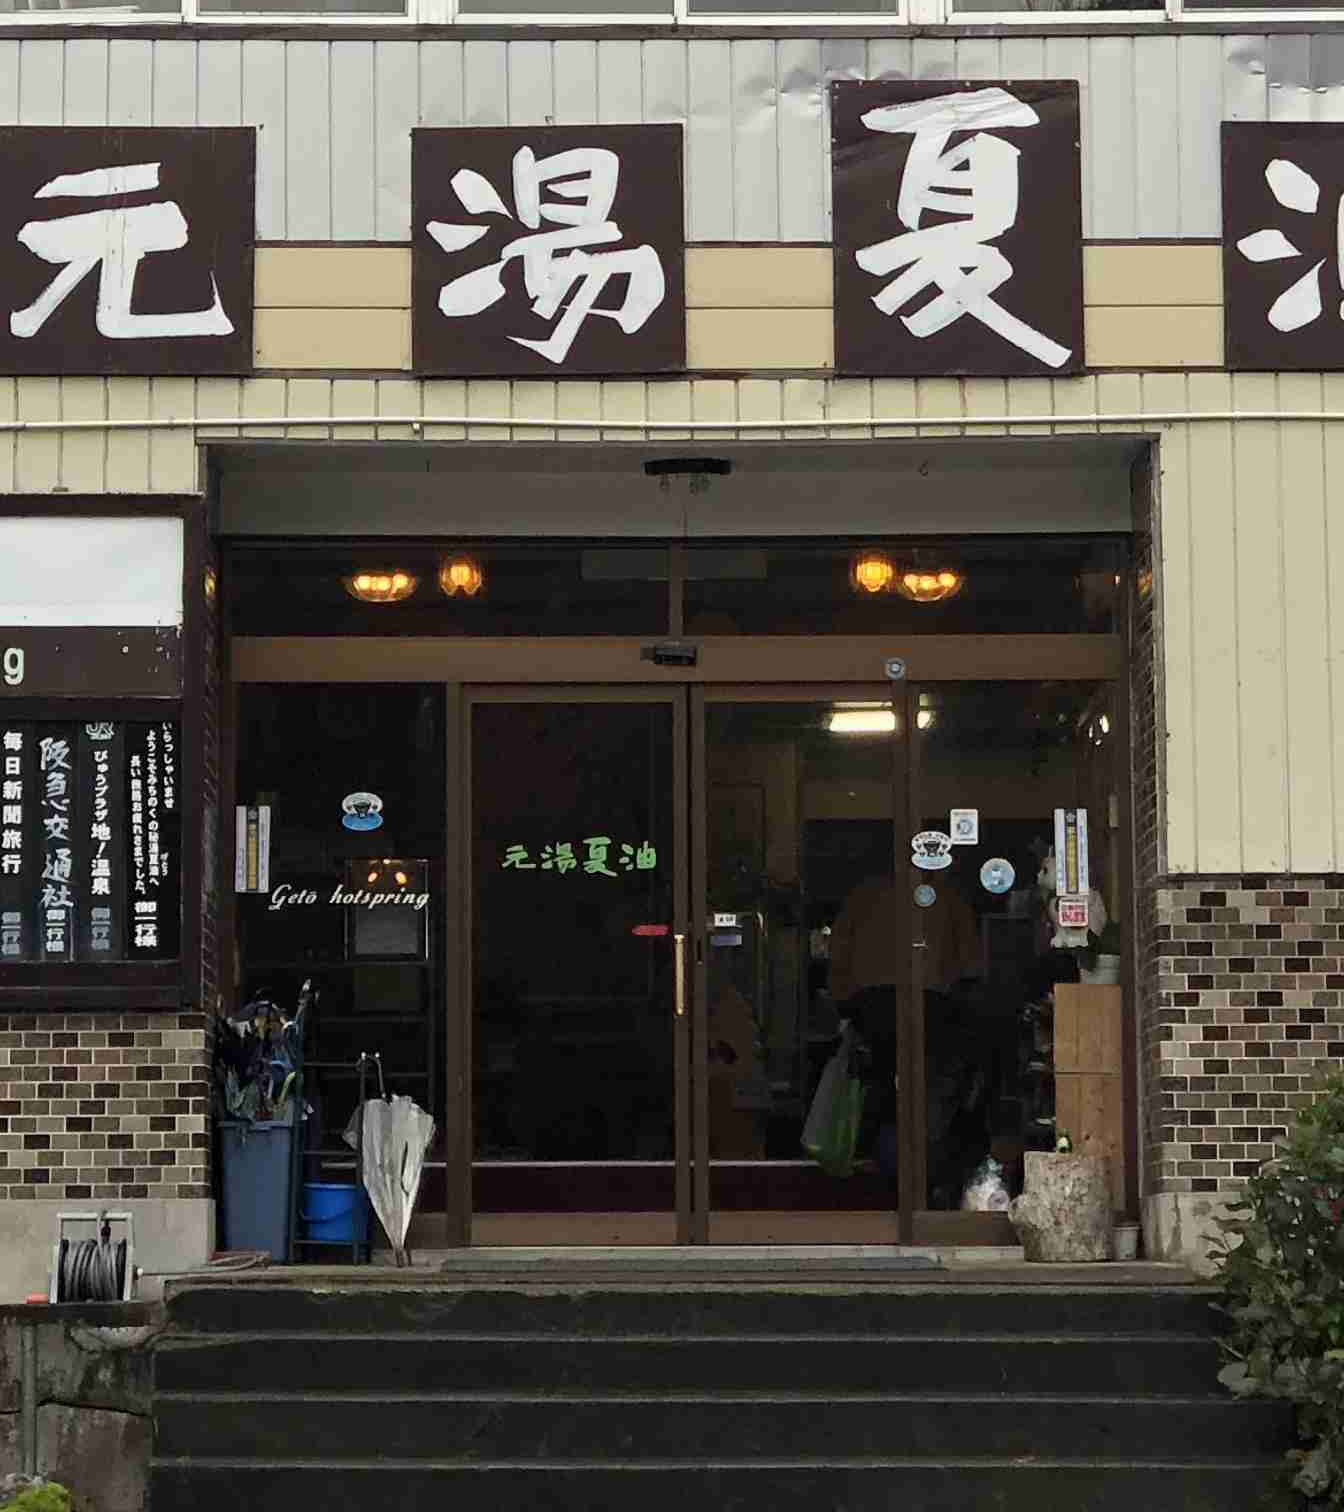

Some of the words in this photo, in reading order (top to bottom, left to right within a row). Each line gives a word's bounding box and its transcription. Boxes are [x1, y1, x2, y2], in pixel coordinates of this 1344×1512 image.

[1, 731, 23, 874] 毎日新聞旅行
[39, 737, 75, 908] 阪急交通社
[162, 722, 175, 809] いらっしゃいませ
[501, 836, 657, 877] 元湯夏油
